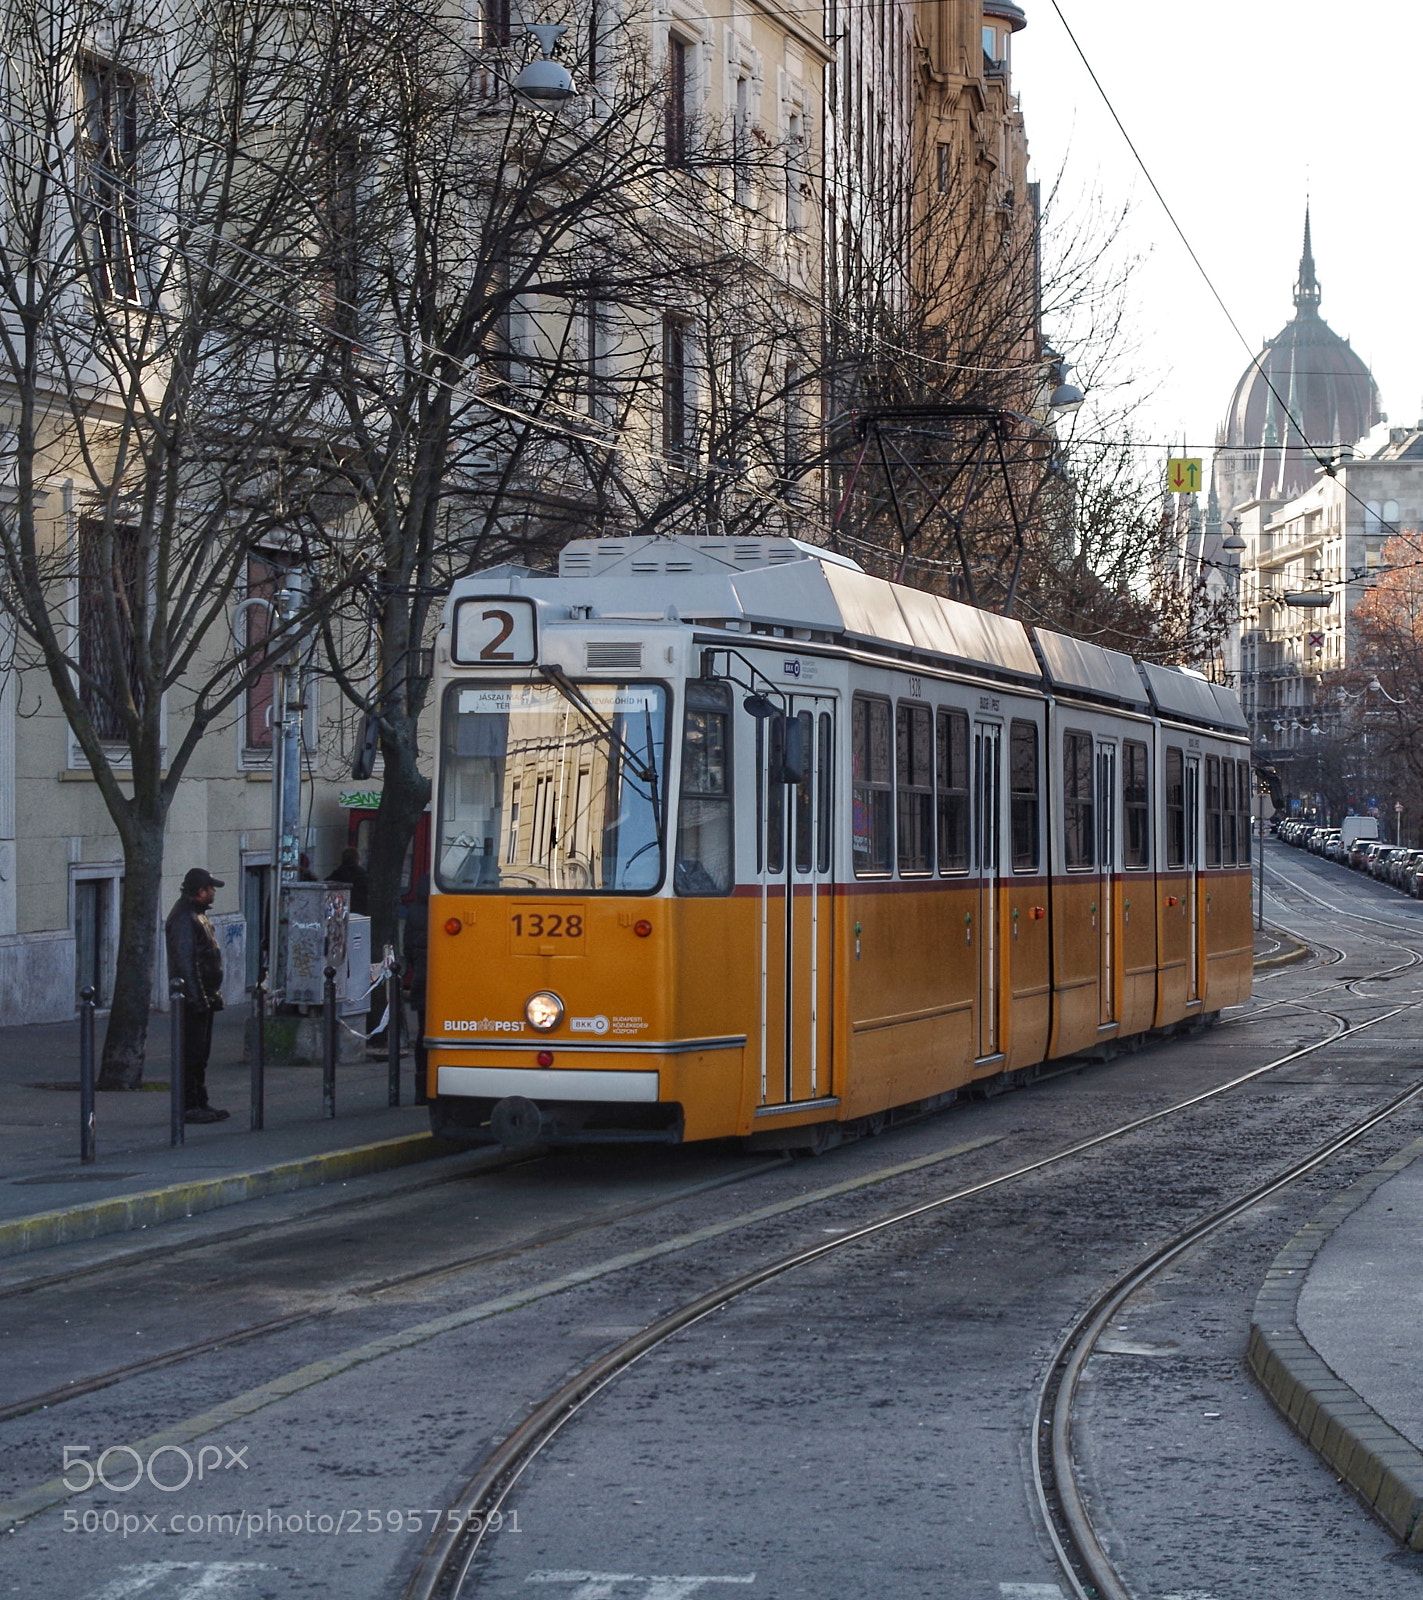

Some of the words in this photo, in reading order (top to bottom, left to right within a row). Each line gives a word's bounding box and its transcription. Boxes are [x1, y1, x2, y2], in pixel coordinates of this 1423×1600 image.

[480, 610, 514, 660] 2
[587, 695, 635, 705] ÖZVÁGÓHÍD
[511, 913, 583, 938] 1328
